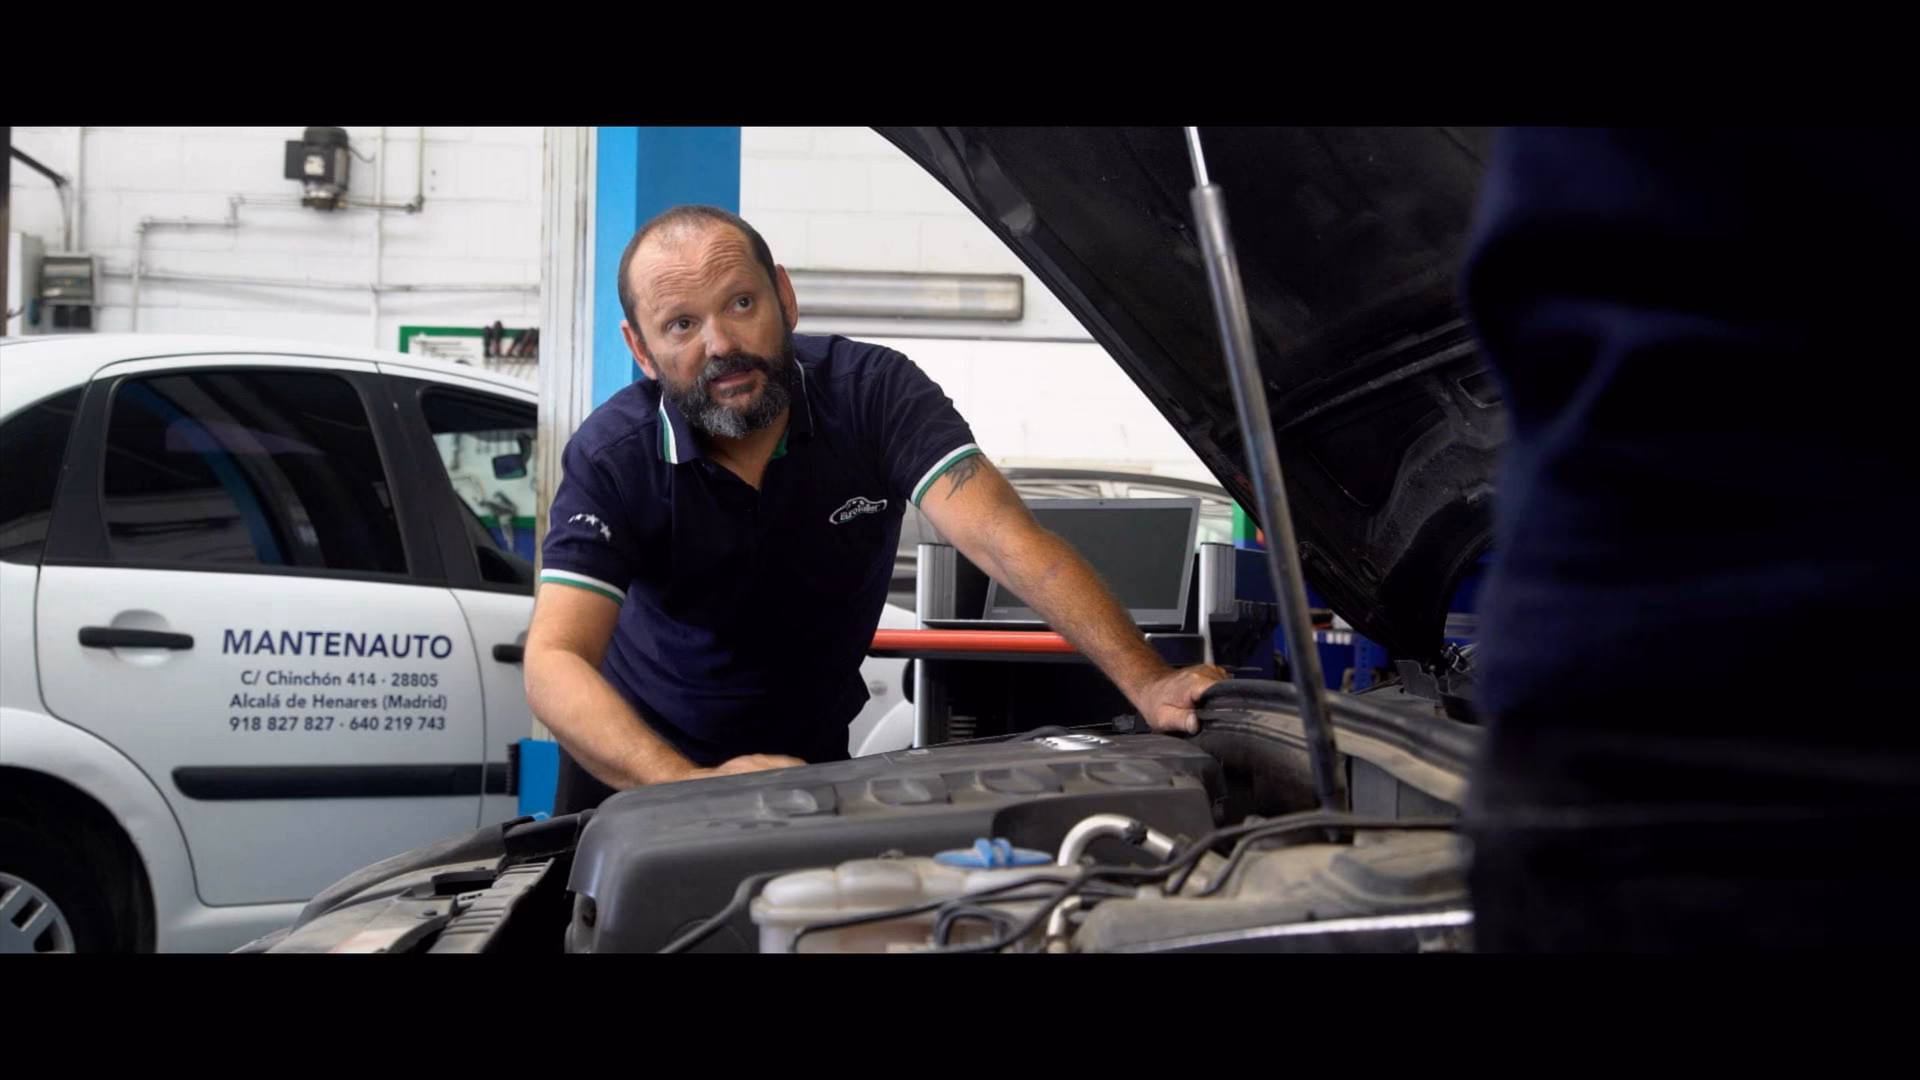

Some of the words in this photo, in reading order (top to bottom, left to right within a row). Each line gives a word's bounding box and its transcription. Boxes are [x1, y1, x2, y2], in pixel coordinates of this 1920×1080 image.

[222, 629, 453, 659] MANTENAUTO
[241, 670, 261, 686] C/
[266, 670, 341, 687] Chinchón
[347, 672, 376, 687] 414
[391, 673, 438, 687] 28805
[229, 693, 281, 709] Alcalá
[286, 694, 307, 709] de
[312, 694, 377, 709] Henares
[382, 694, 448, 711] (Madrid)
[229, 716, 261, 731] 918
[267, 716, 298, 731] 827
[303, 716, 334, 731] 827
[349, 716, 379, 731] 640
[384, 716, 413, 731] 219
[418, 716, 446, 731] 743
